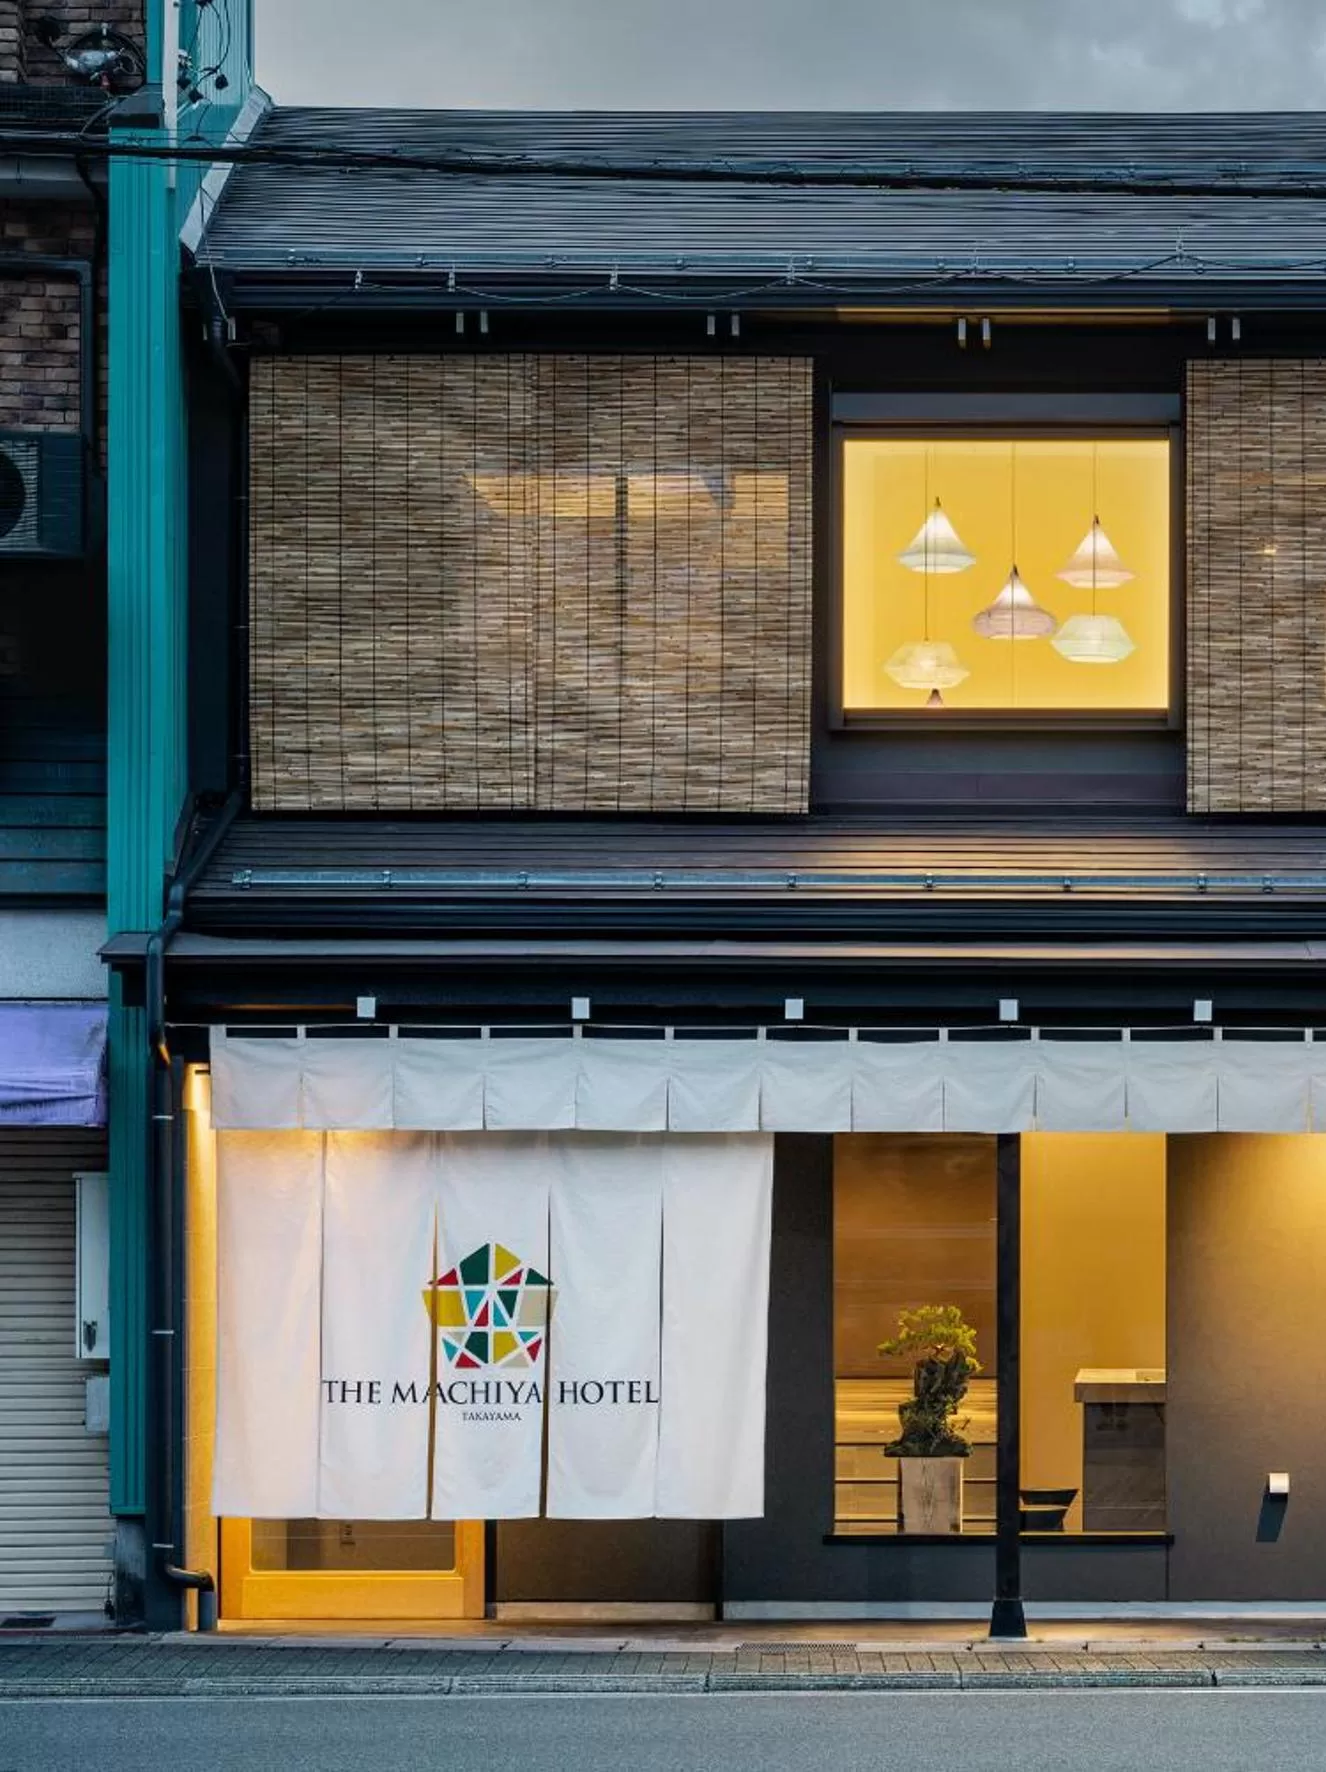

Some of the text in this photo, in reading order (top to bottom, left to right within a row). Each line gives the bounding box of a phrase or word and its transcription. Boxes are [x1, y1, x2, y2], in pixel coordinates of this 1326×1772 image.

[322, 1380, 659, 1404] THE MACHIYA HOTEL
[462, 1411, 522, 1421] TAKAYAMA
